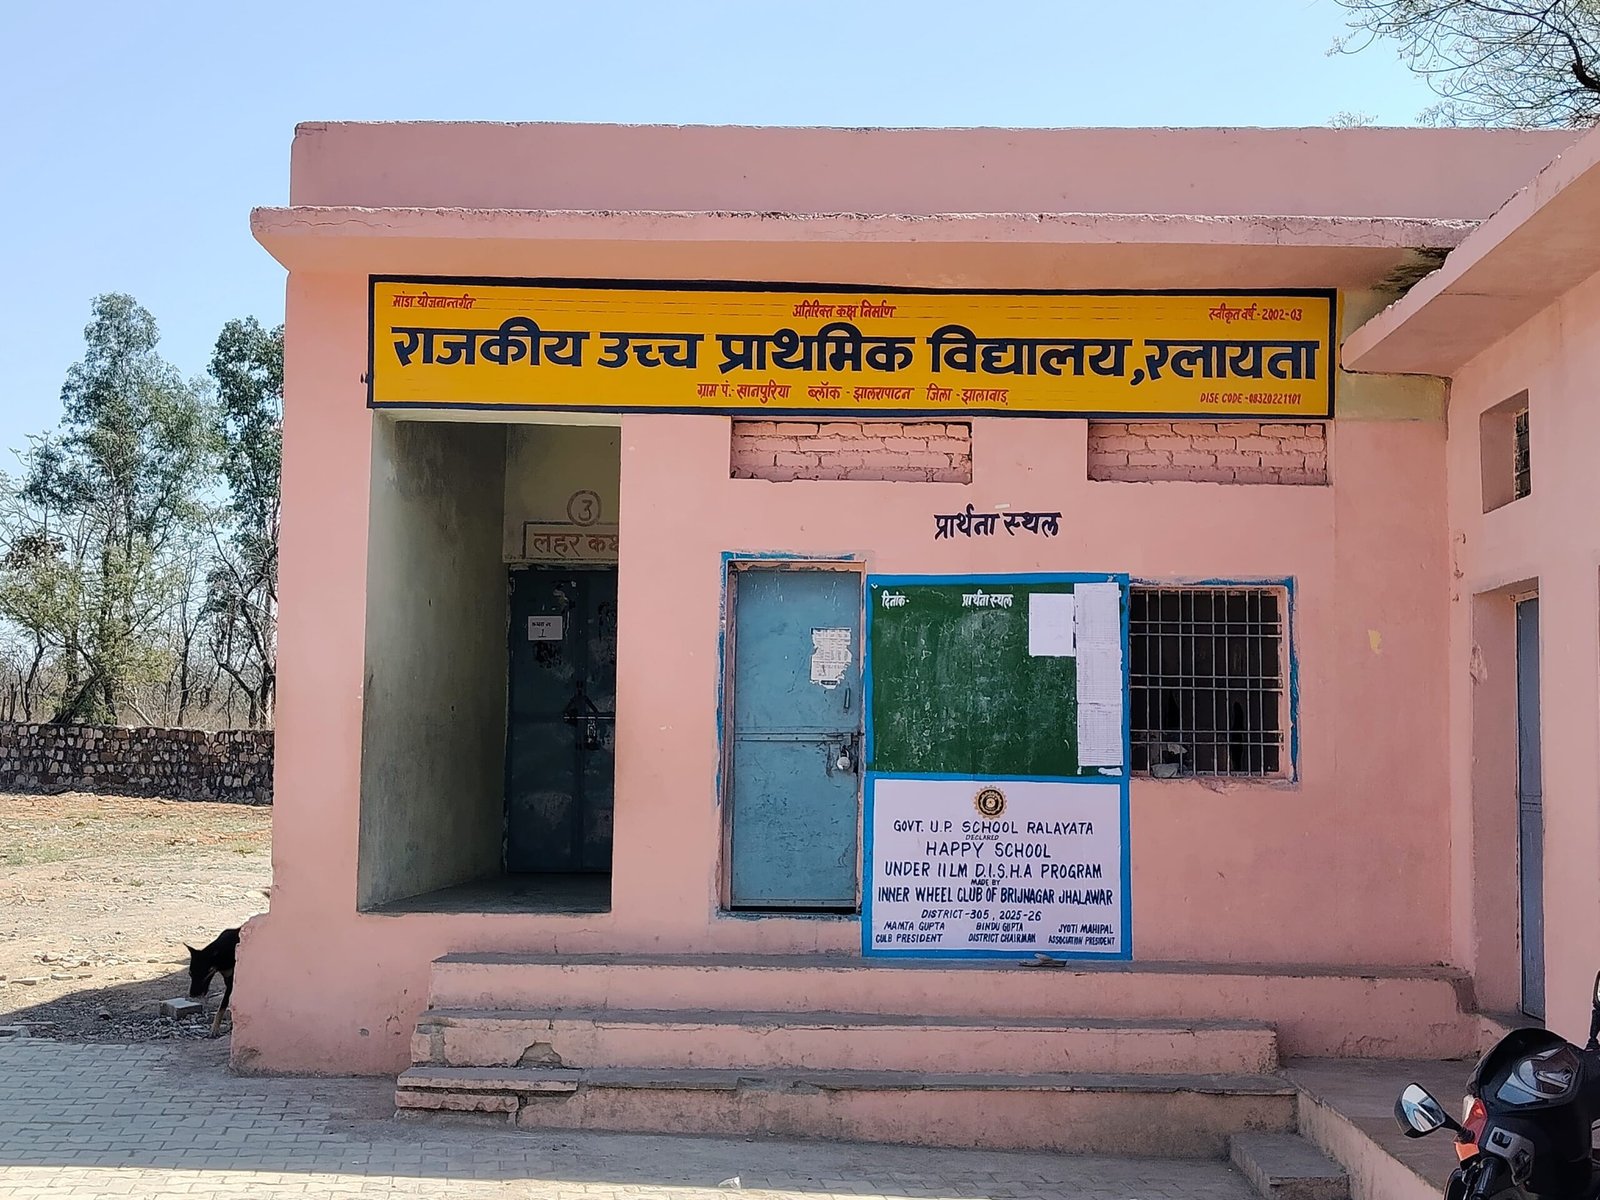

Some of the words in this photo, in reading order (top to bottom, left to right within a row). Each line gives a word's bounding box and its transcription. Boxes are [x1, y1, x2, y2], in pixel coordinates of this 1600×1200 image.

[792, 299, 836, 319] अतिरिक्त
[836, 305, 859, 321] कक्ष
[860, 299, 897, 318] निर्माण
[1208, 302, 1242, 325] स्वीकृत
[391, 316, 590, 367] राजकीय
[597, 331, 705, 369] उच्च
[715, 322, 916, 375] प्राथमिक
[1144, 338, 1320, 381] रलायता
[808, 381, 842, 402] ब्लॉक
[926, 382, 953, 402] जिला
[1200, 392, 1219, 404] DISE
[1221, 393, 1243, 404] CODE
[1002, 511, 1063, 538] स्थल
[533, 532, 584, 558] लहर
[990, 593, 1014, 609] स्थल
[893, 820, 924, 833] GOVT.
[961, 821, 1019, 834] SCHOOL
[1026, 822, 1094, 835] RALAYATA
[926, 841, 984, 859] HAPPY
[994, 842, 1051, 858] SCHOOL
[885, 861, 930, 877] UNDER
[937, 862, 968, 878] IILM
[1041, 864, 1103, 880] PROGRAM
[970, 879, 989, 887] MADE
[991, 879, 1001, 887] BY
[878, 886, 910, 903] INNER
[915, 887, 953, 903] WHEEL
[957, 887, 983, 903] CLUB
[985, 887, 998, 903] OF
[1000, 887, 1055, 905] BRIJNAGAR
[1058, 889, 1113, 906] JHALAWAR
[999, 910, 1042, 922] 2025-26
[883, 921, 914, 931] MAMTA
[918, 921, 945, 931] GUPTA
[975, 922, 1000, 931] BINDU
[1002, 922, 1024, 932] GUPTA
[1058, 923, 1078, 934] JYOTI
[1080, 924, 1114, 935] MAHIPAL
[896, 933, 943, 944] PRESIDENT
[968, 933, 999, 943] DISTRICT
[1000, 933, 1037, 943] CHAIRMAN
[1084, 936, 1116, 946] PRESIDENT
